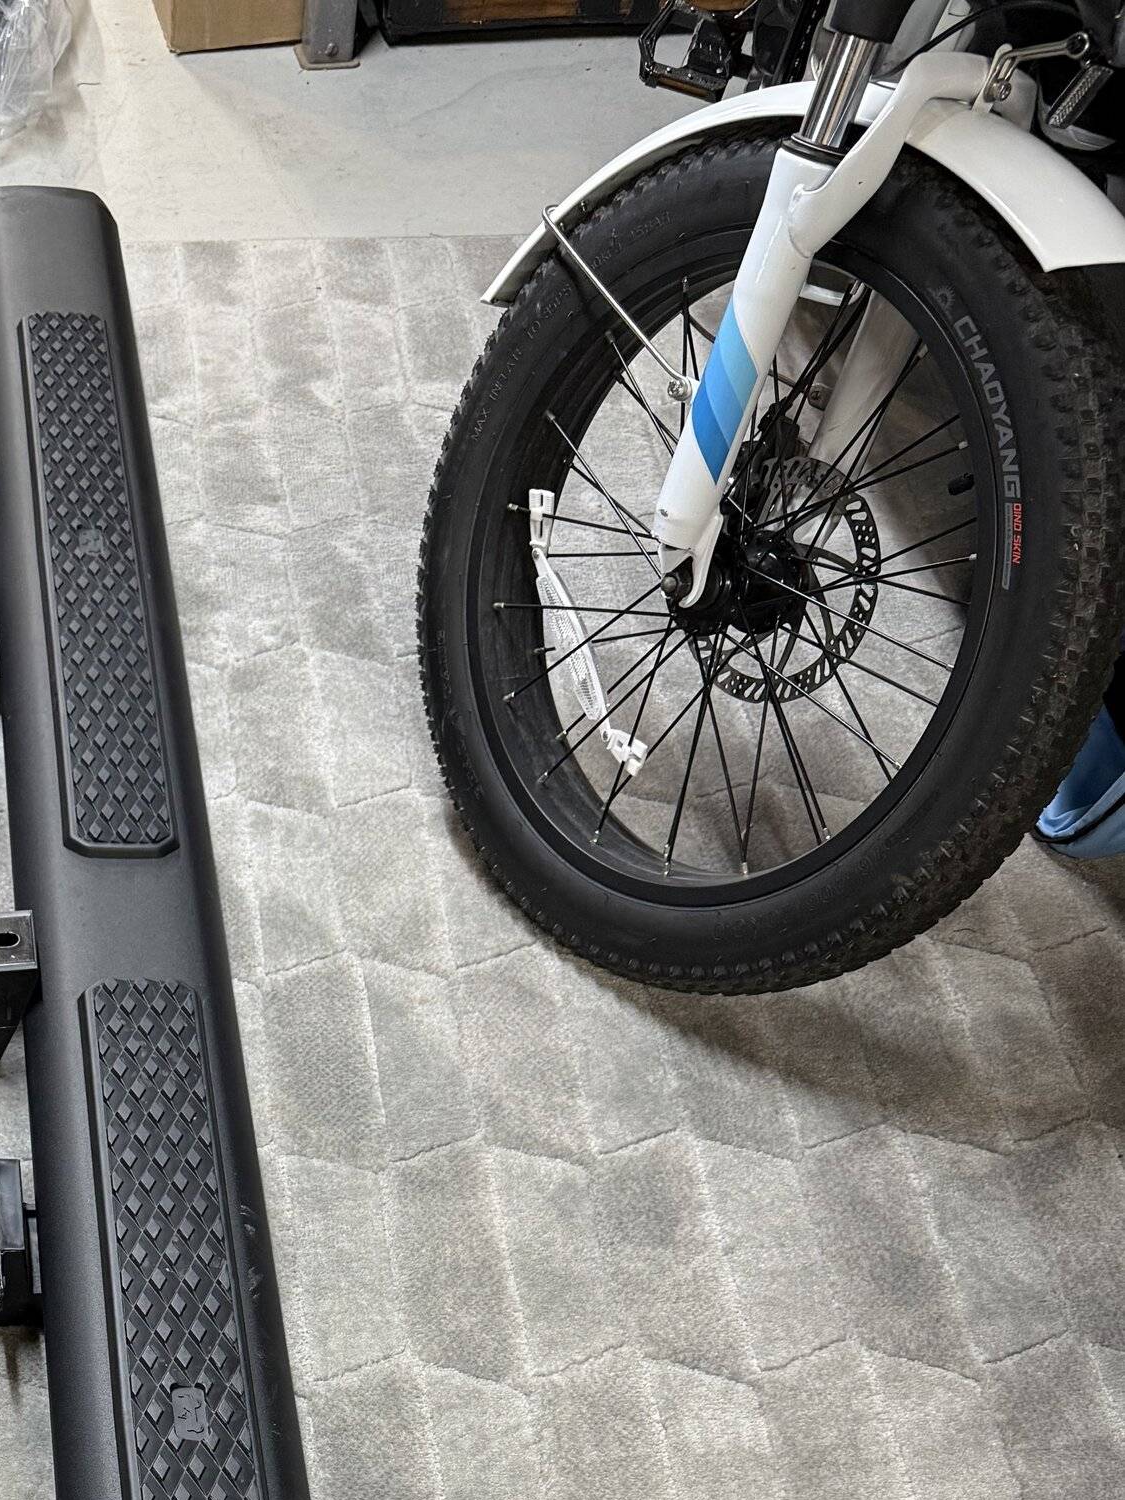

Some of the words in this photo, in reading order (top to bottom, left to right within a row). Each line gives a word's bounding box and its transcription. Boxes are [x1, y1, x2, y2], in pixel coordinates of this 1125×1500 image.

[953, 315, 1022, 498] CHAOYANG
[1013, 503, 1023, 531] DINO
[1012, 534, 1022, 564] SKIN
